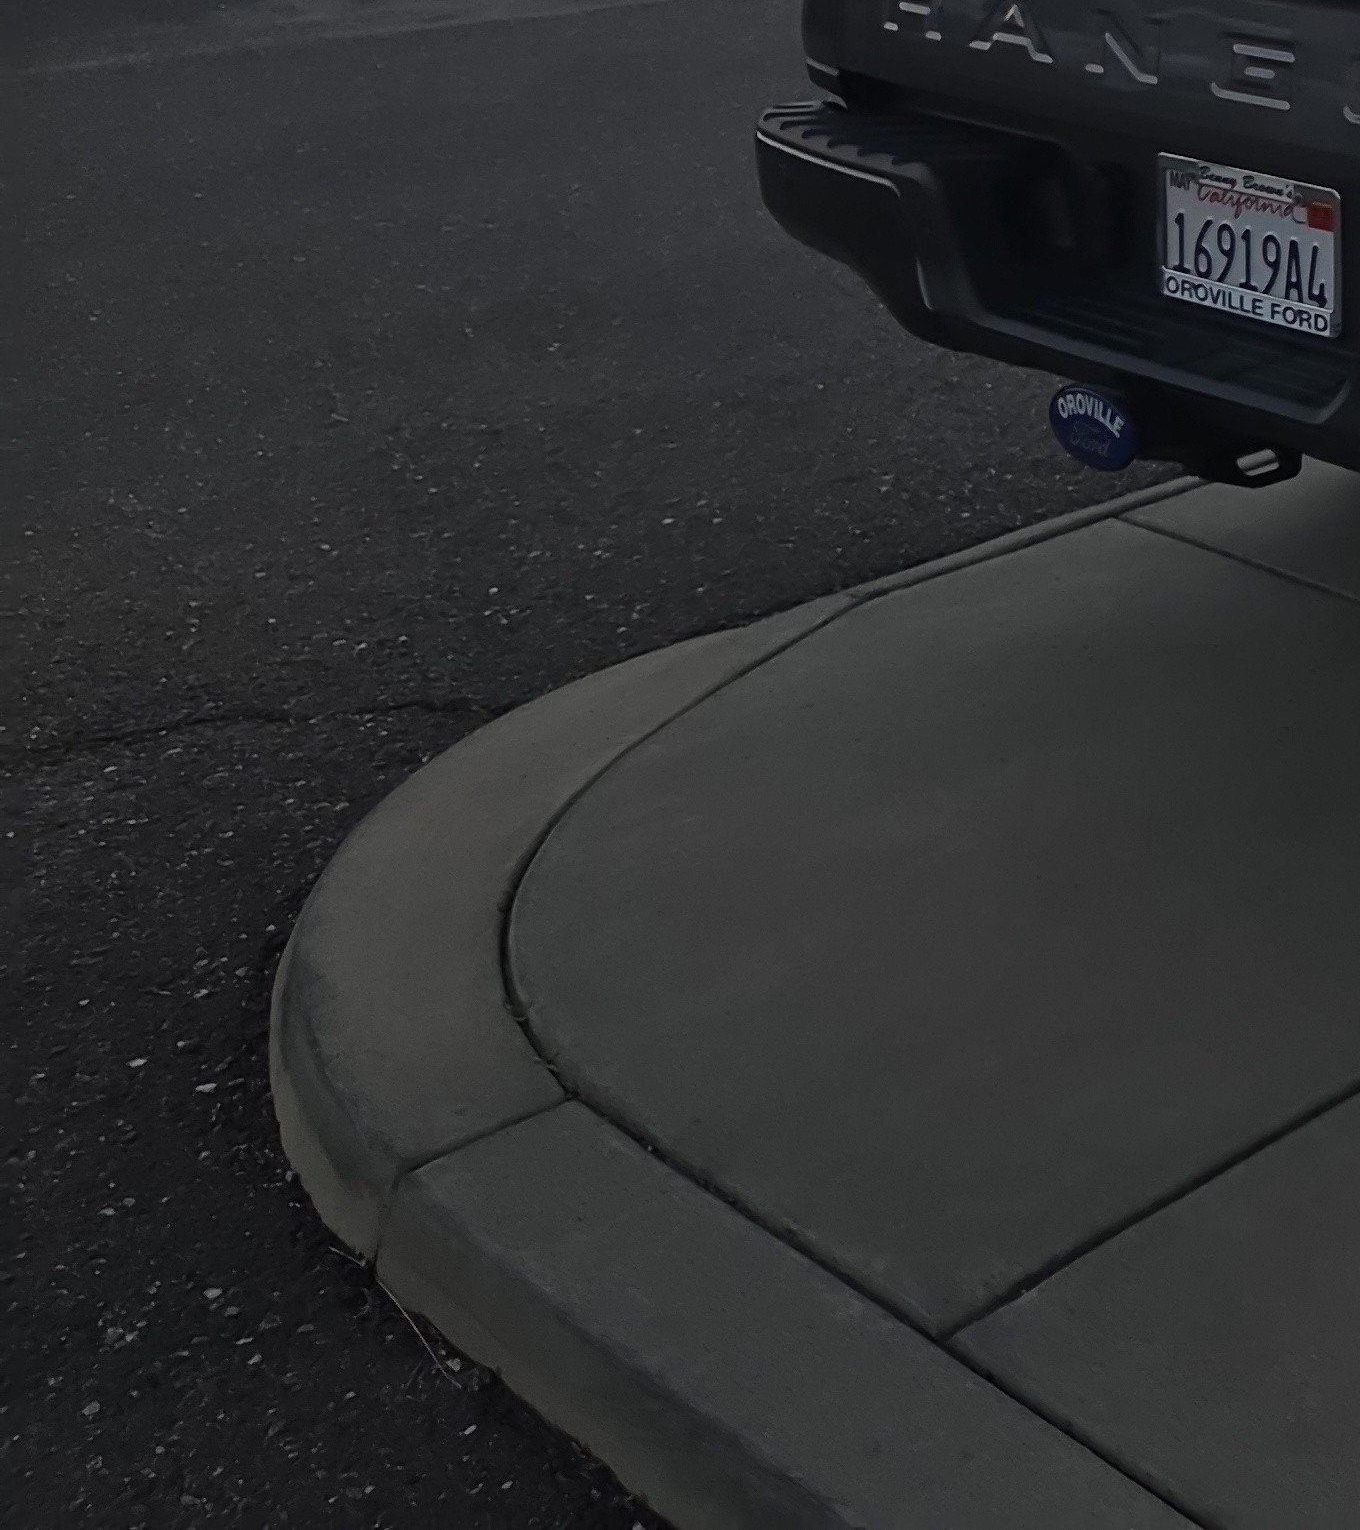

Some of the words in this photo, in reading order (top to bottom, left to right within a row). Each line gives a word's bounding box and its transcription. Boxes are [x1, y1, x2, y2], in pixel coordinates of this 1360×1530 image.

[1198, 183, 1295, 219] California
[1172, 212, 1328, 309] 16919A4
[1166, 276, 1264, 317] OROVILLE
[1270, 303, 1328, 332] FORD
[1057, 393, 1125, 438] OROVILLE
